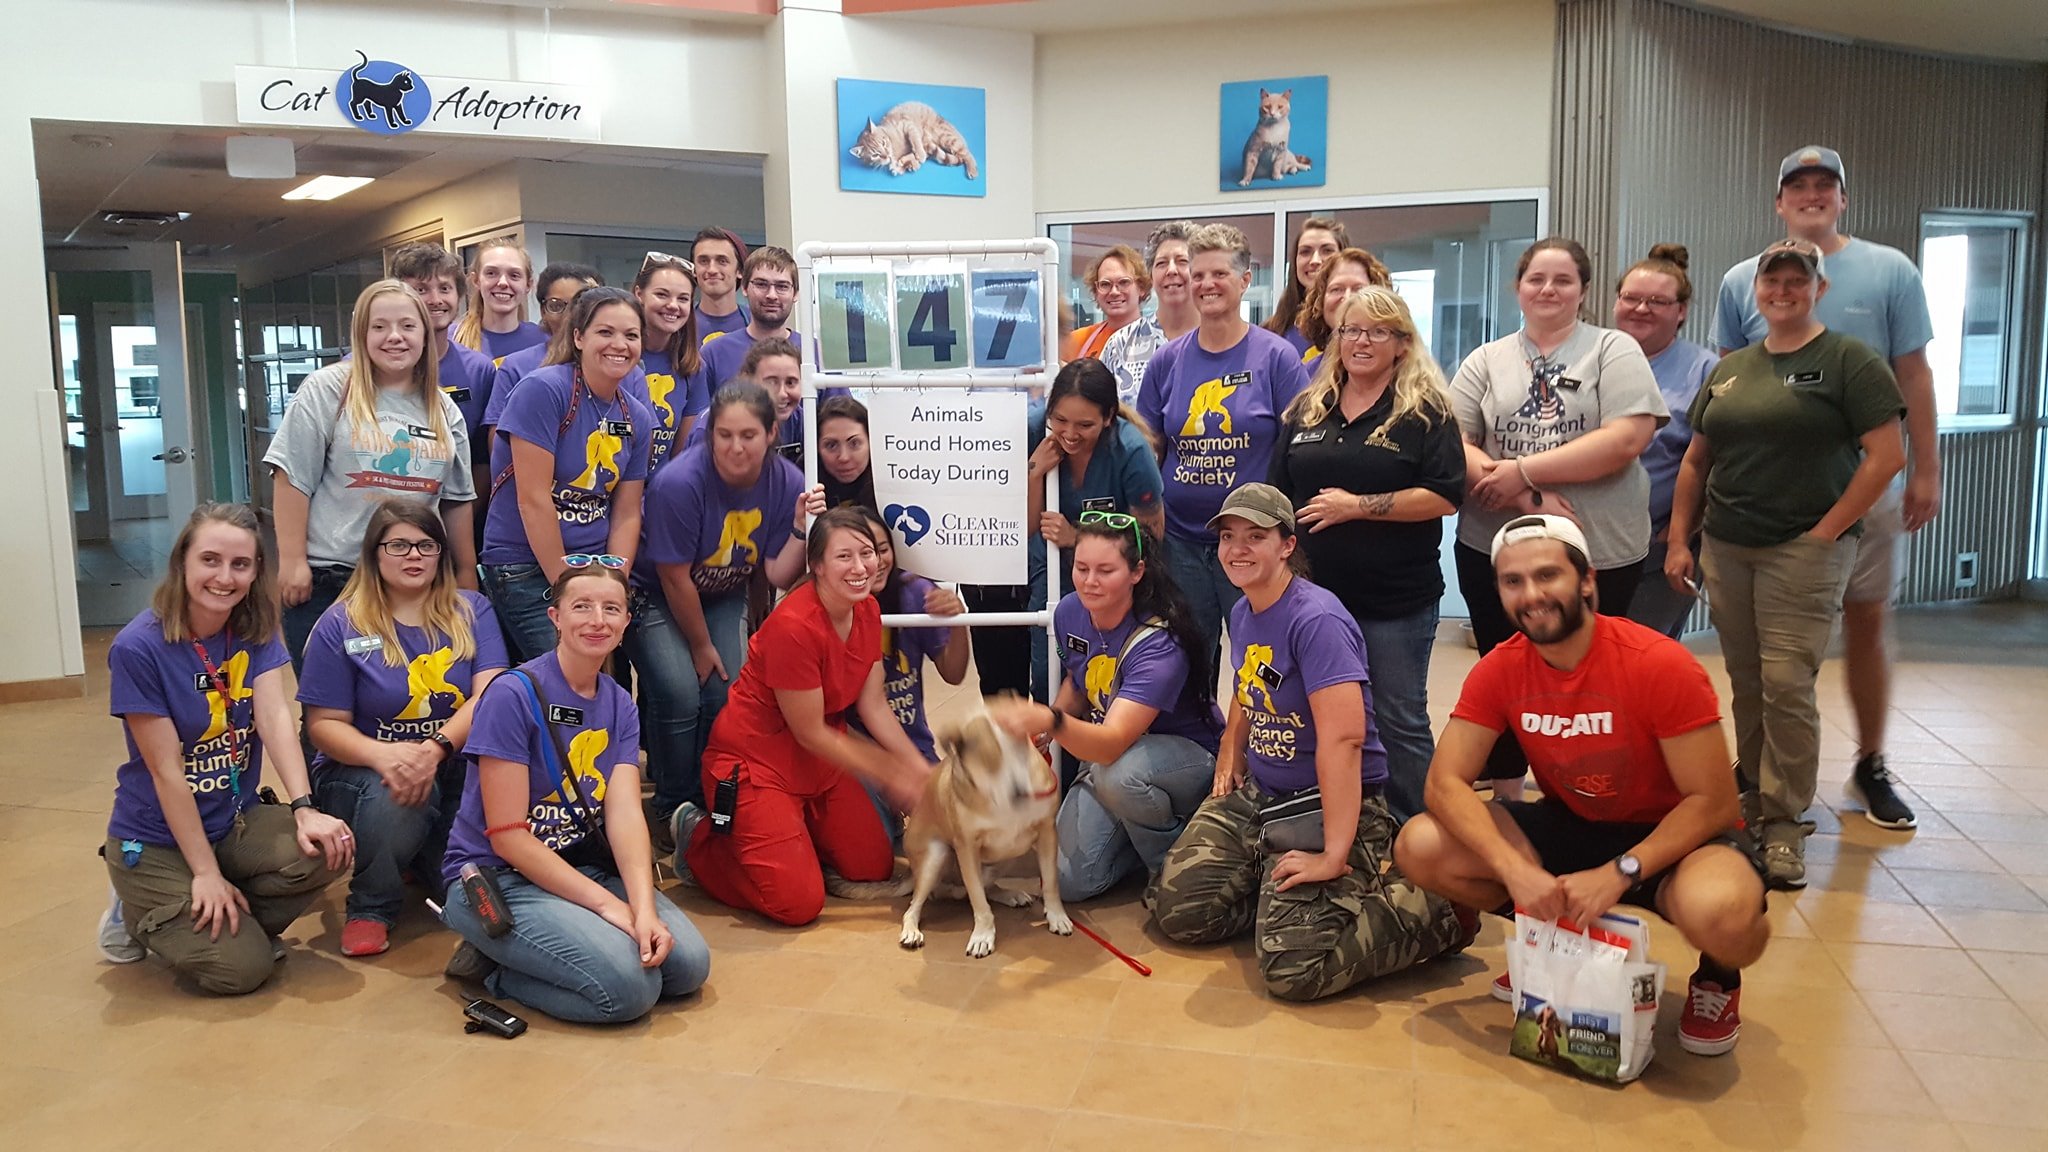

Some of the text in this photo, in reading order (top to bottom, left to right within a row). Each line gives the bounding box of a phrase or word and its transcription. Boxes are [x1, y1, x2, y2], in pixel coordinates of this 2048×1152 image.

[260, 79, 582, 131] Cat Adoption
[911, 406, 984, 422] Animals
[1494, 413, 1586, 439] Longmont
[885, 435, 1012, 451] Found Homes
[1170, 432, 1250, 454] Longmont
[1176, 450, 1236, 468] Humane
[887, 463, 1009, 485] Today During
[1173, 465, 1237, 489] Society
[942, 513, 1019, 530] CLEAR THE
[935, 529, 1019, 547] SHELTERS
[1521, 711, 1613, 739] DUCATI
[1569, 1028, 1606, 1042] FRIEND
